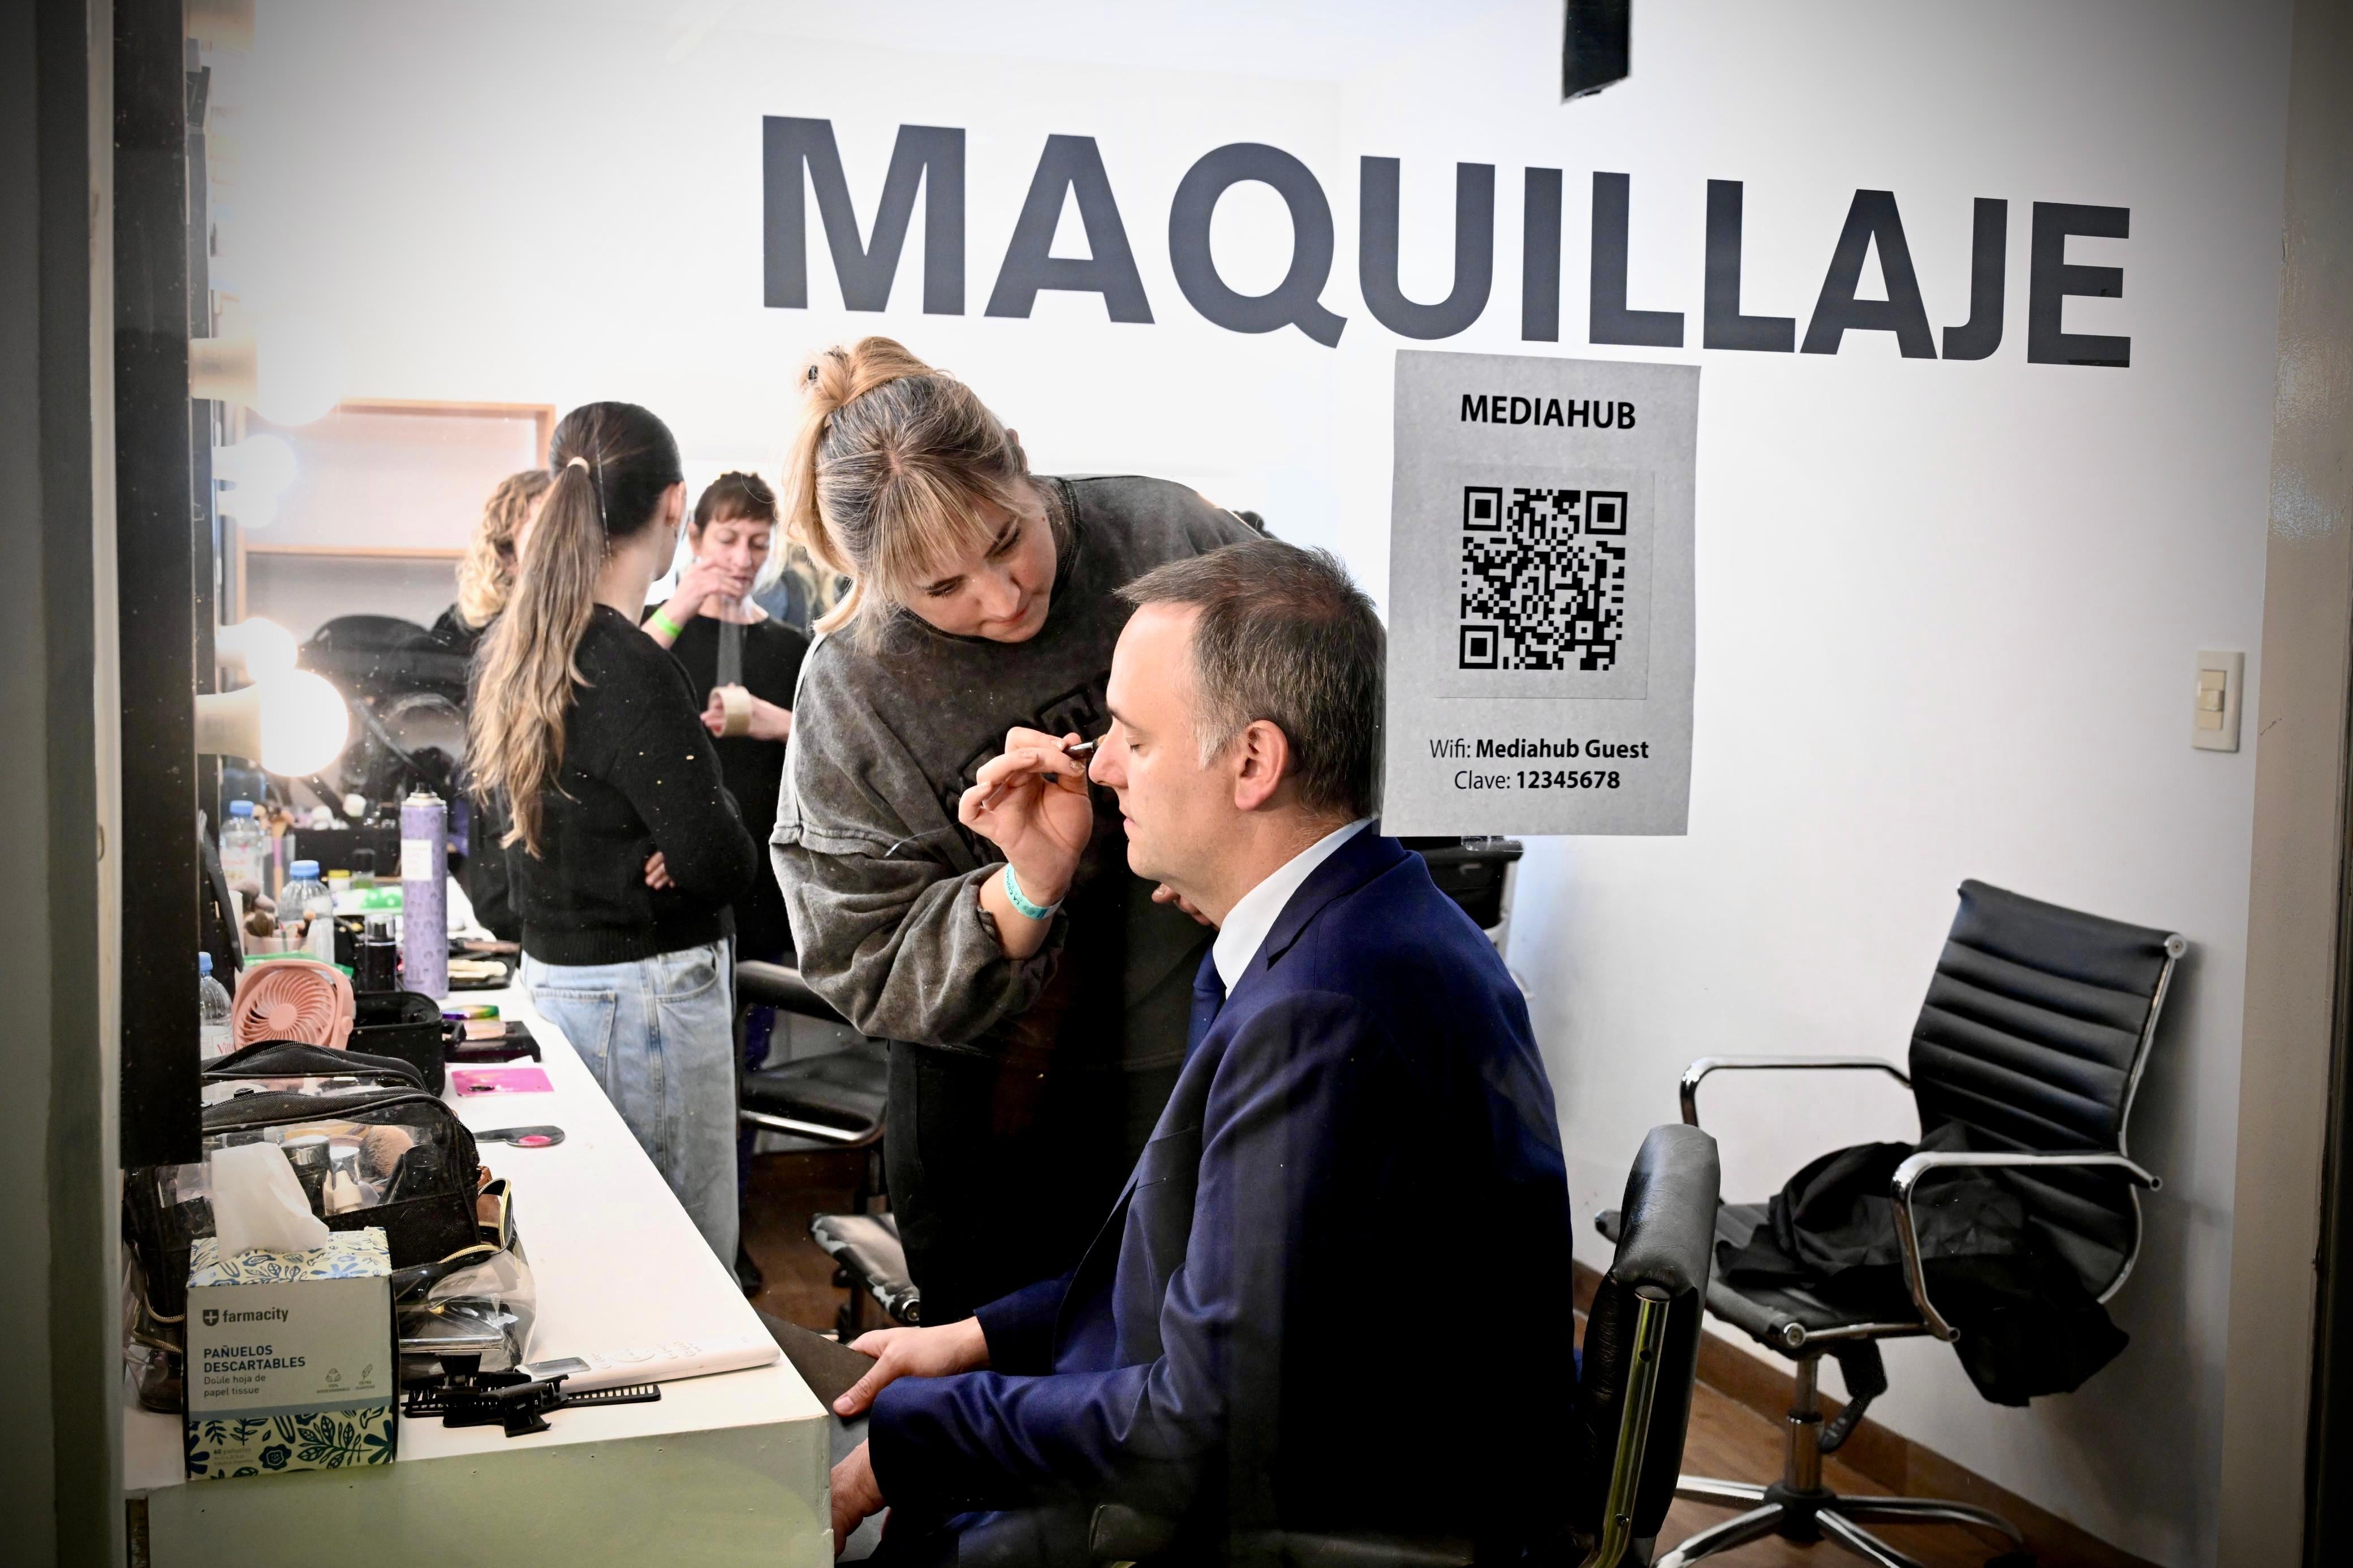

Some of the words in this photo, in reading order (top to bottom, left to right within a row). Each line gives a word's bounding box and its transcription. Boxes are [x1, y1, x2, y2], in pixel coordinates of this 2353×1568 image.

[762, 115, 2132, 369] MAQUILLAJE
[1460, 394, 1636, 430] MEDIAHUB
[1429, 737, 1471, 759] Wifi:
[1476, 737, 1580, 759] Mediahub
[1584, 738, 1649, 759] Guest
[1454, 770, 1511, 790] Clave:
[1516, 770, 1621, 789] 12345678
[223, 1307, 289, 1323] farmacity
[204, 1345, 273, 1359] PAÑUELOS
[204, 1356, 306, 1373] DESCARTABLES
[204, 1375, 230, 1385] Doble
[232, 1375, 252, 1384] hoja
[255, 1373, 266, 1382] de
[204, 1388, 229, 1398] papel
[232, 1387, 260, 1396] tissue
